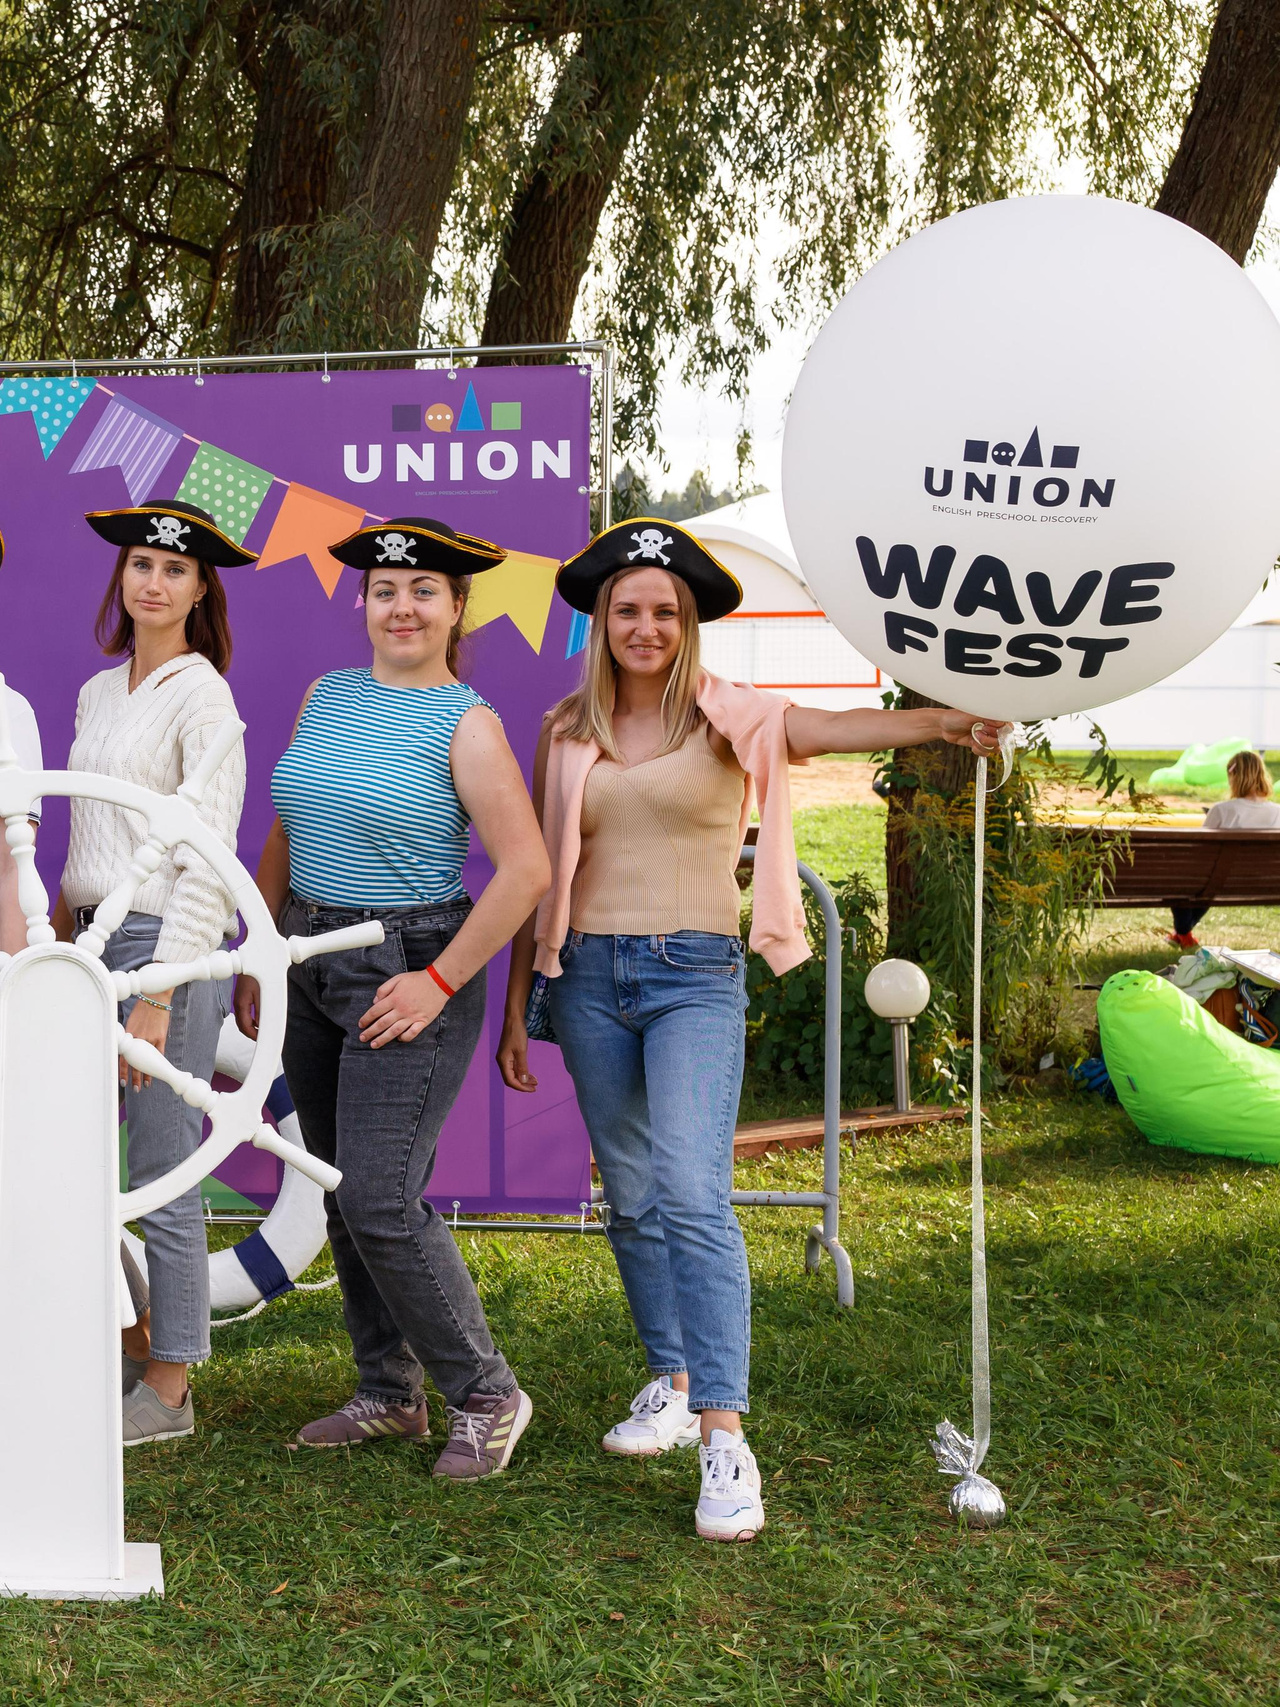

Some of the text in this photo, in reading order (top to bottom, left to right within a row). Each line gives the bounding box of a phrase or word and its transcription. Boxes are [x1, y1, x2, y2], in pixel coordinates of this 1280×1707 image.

[343, 439, 571, 484] UNION
[924, 466, 1116, 508] UNION
[931, 504, 1099, 524] ENGLISH PRESCHOOL DISCOVERY
[855, 535, 1176, 627] WAVE
[883, 610, 1130, 679] FEST
